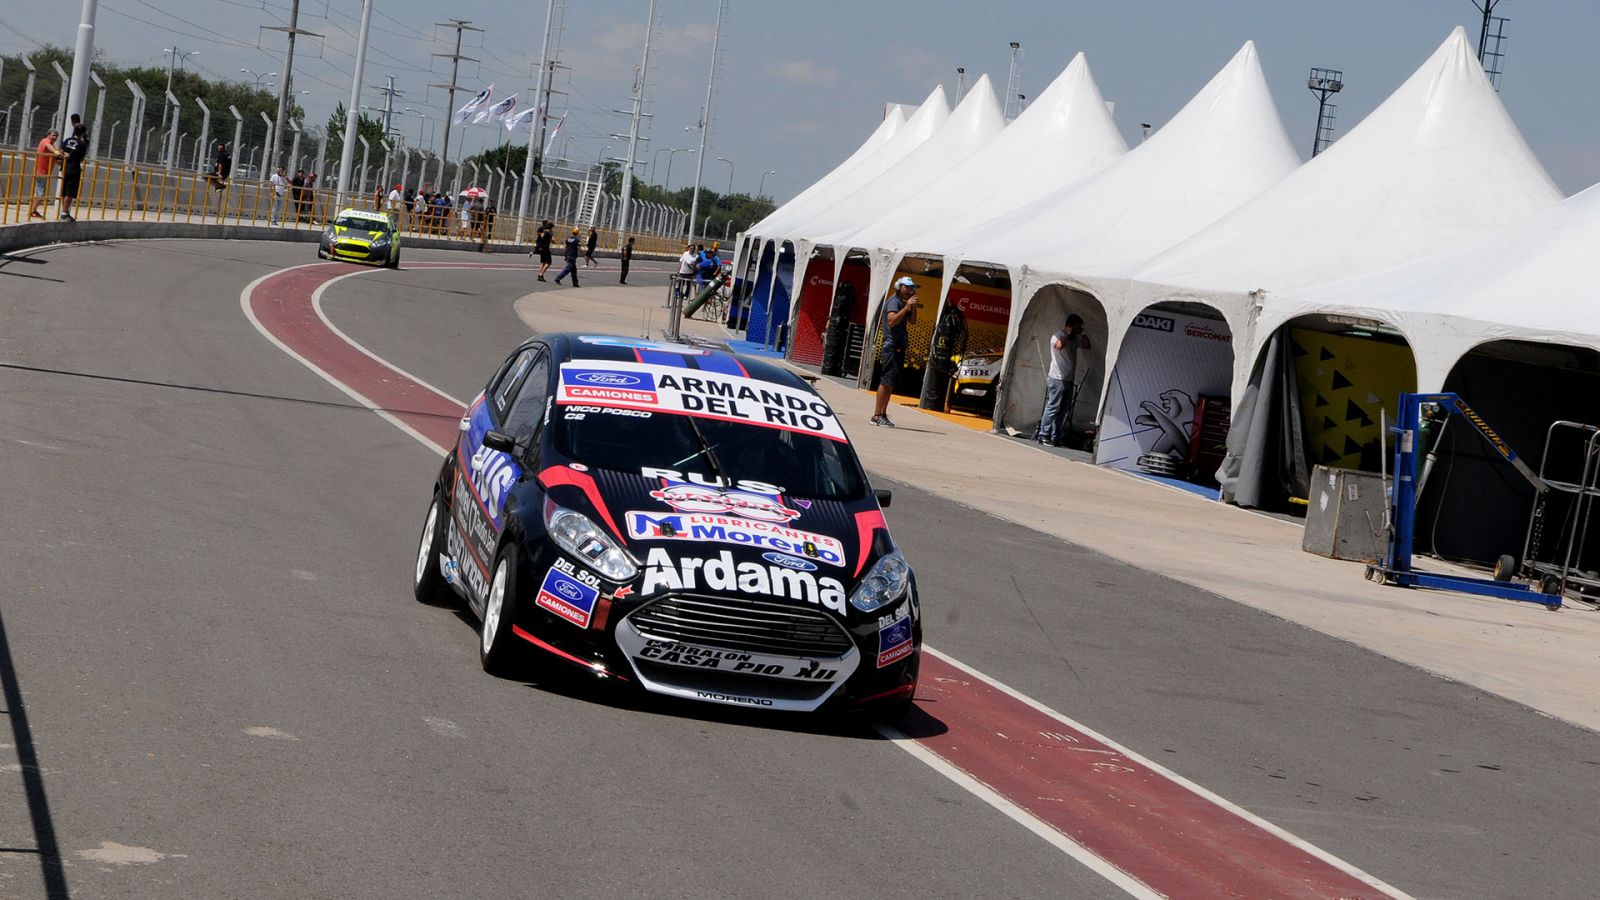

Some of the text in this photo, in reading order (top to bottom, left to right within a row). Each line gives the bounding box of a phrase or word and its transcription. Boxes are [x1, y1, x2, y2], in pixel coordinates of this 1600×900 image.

[1185, 328, 1232, 342] BERCOMAT
[564, 405, 601, 413] NICO
[570, 388, 653, 402] CAMIONES
[658, 373, 833, 418] ARMANDO
[681, 393, 825, 431] DEL RIO
[641, 466, 782, 495] RUS
[690, 516, 835, 548] LUBRICANTES
[553, 557, 602, 589] DEL SOL
[641, 547, 848, 617] Ardama
[540, 595, 585, 623] CAMIONES
[878, 613, 895, 628] DEL
[639, 648, 838, 680] CASA PIO XII
[880, 643, 913, 663] CAMIONES
[697, 691, 773, 706] MORENO
